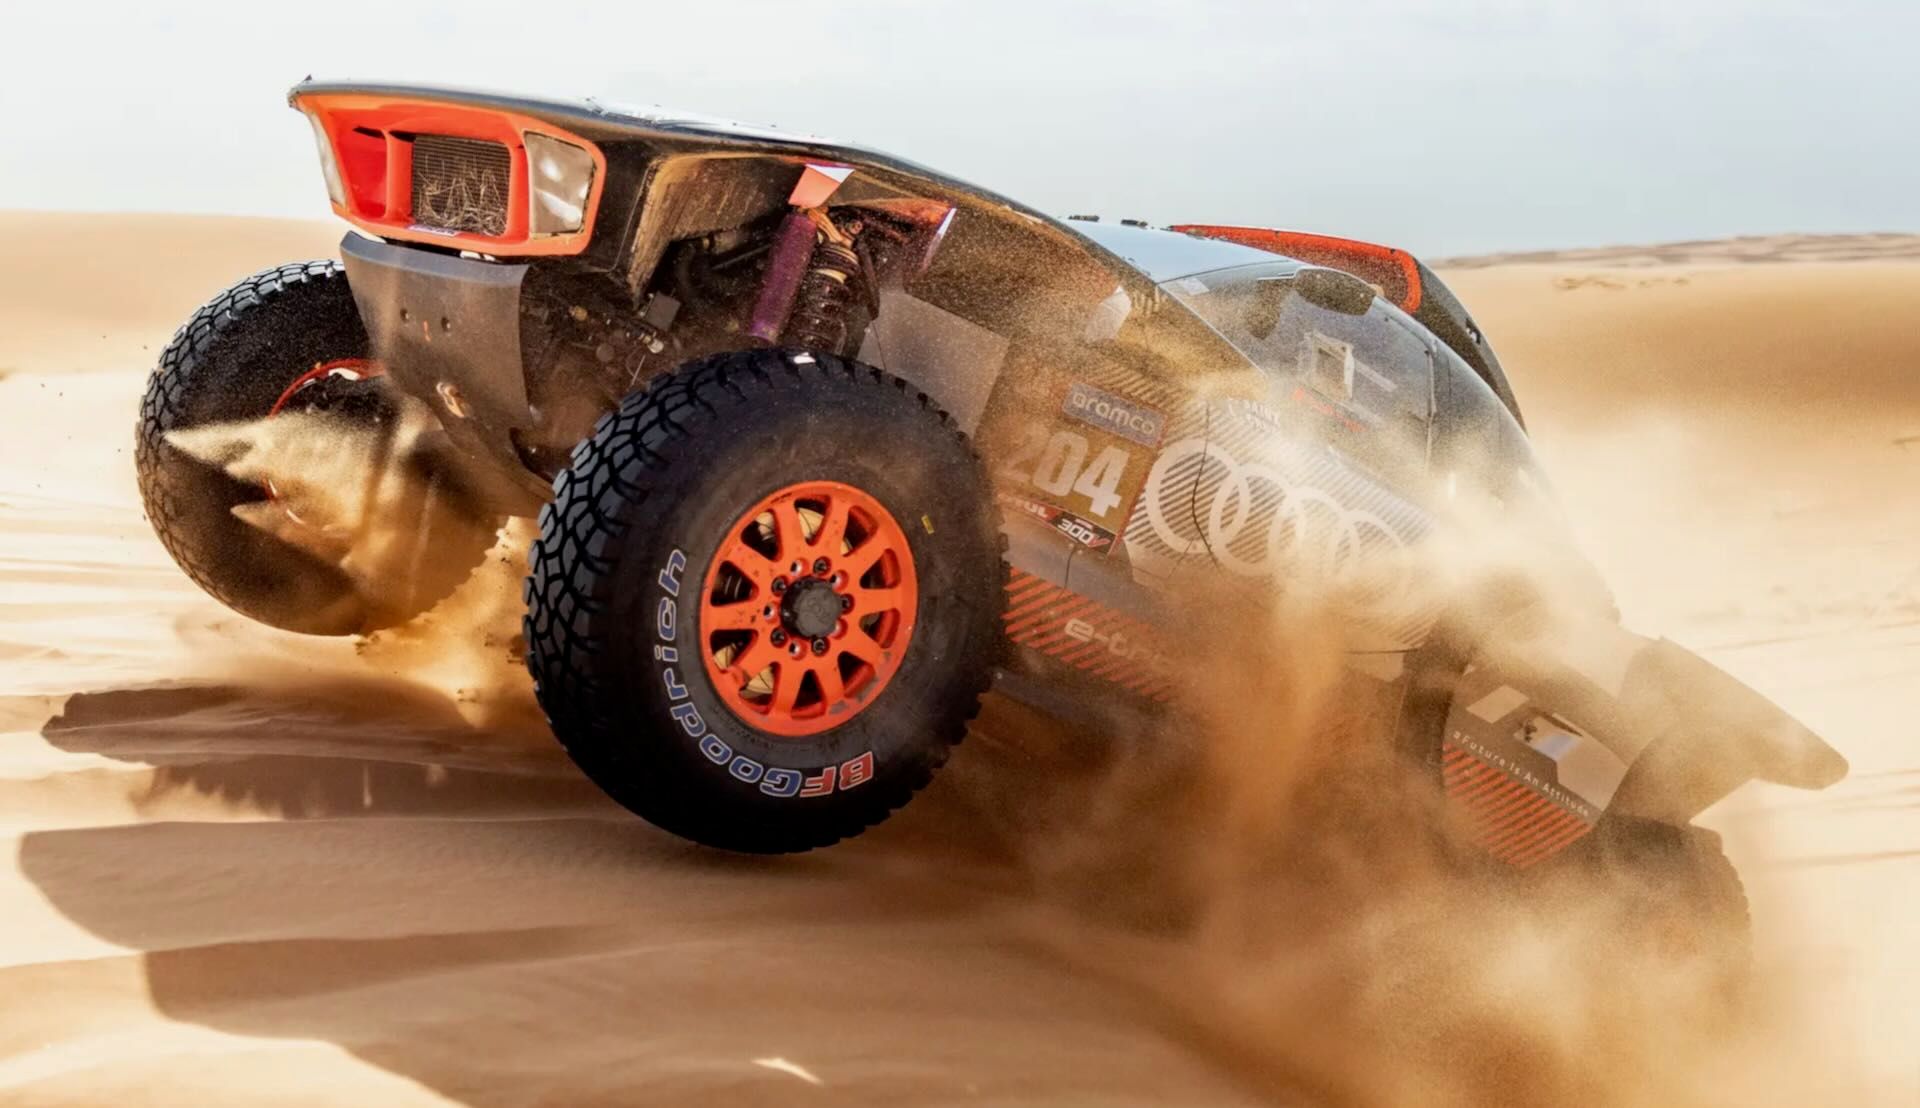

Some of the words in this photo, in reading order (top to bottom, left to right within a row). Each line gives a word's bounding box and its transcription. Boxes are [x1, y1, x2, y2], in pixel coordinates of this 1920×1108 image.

[1071, 391, 1156, 436] aramco
[991, 421, 1131, 518] 204
[1057, 517, 1111, 548] 300V
[654, 548, 874, 798] BFGoodrich
